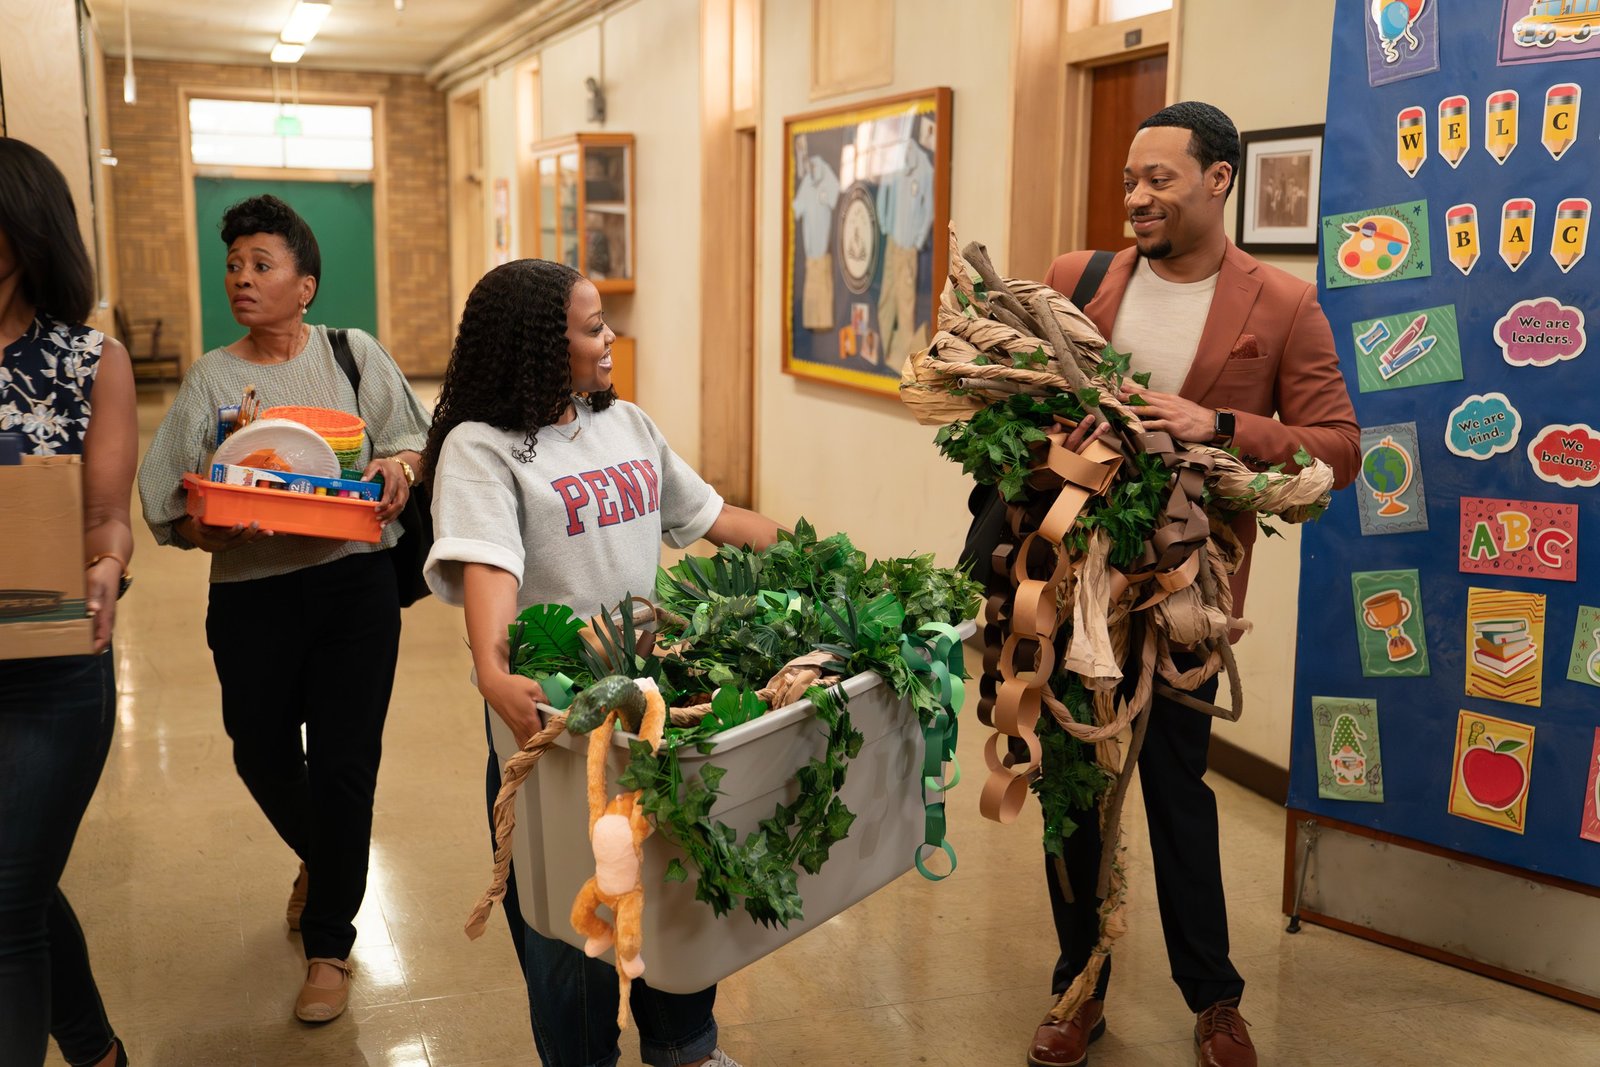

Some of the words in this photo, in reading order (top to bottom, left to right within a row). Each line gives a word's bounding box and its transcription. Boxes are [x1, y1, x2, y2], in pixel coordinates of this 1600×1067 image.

[1518, 316, 1541, 329] We
[1546, 319, 1570, 330] are
[1511, 331, 1573, 345] leaders.
[1457, 420, 1480, 432] We
[1483, 411, 1506, 426] are
[1468, 427, 1505, 446] kind.
[1561, 438, 1583, 452] We
[1541, 450, 1597, 472] belong.
[550, 459, 660, 537] PENN
[1467, 510, 1573, 569] ABC
